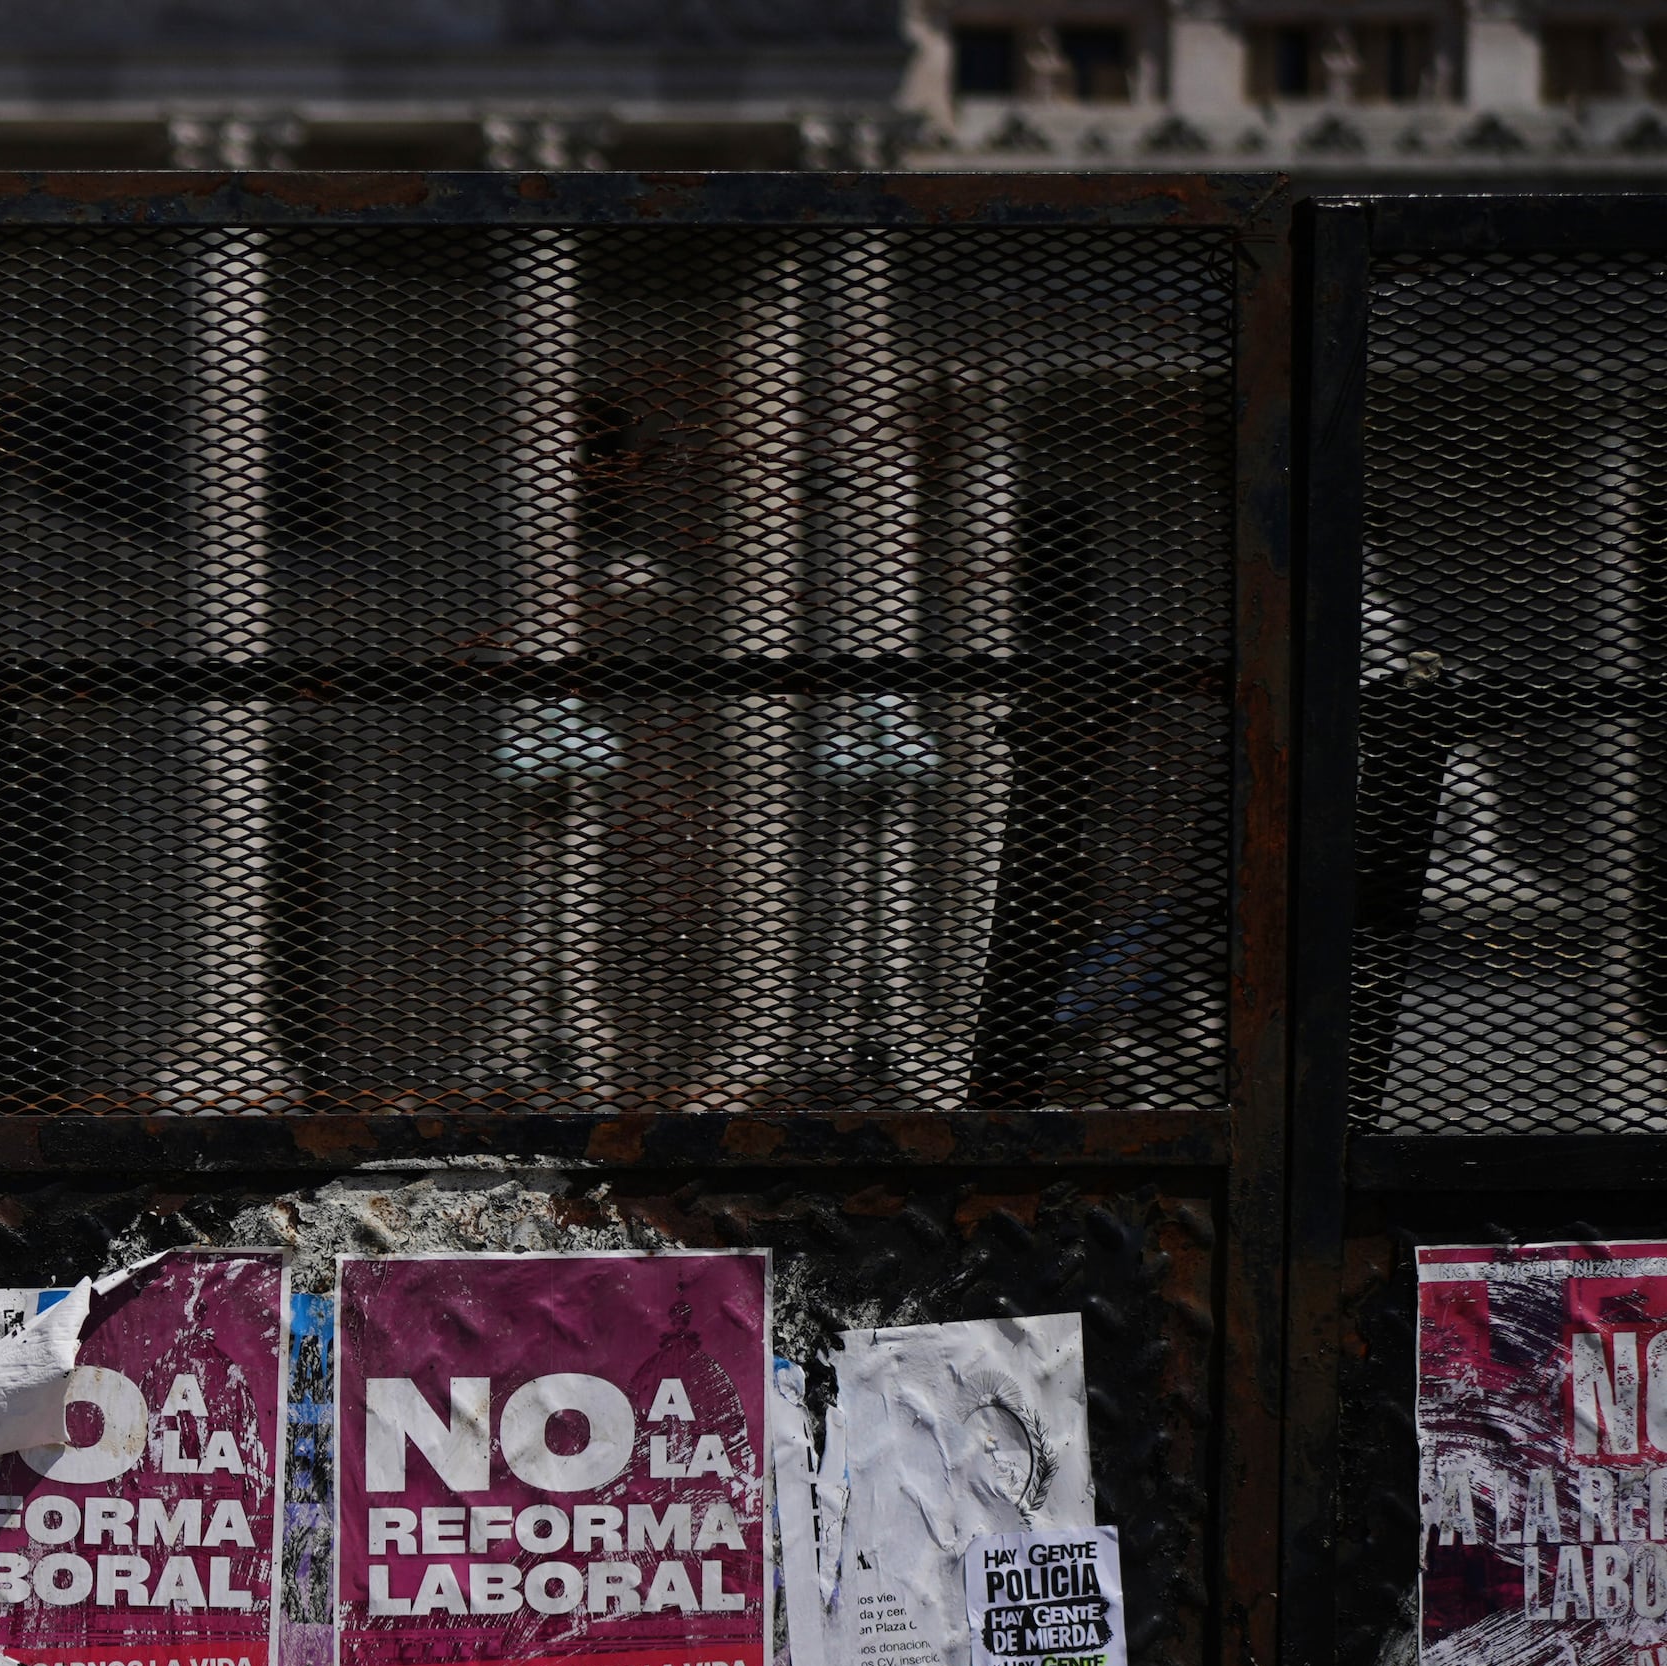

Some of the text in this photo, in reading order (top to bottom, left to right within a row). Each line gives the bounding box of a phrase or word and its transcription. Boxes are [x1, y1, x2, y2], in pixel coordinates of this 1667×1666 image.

[162, 1374, 208, 1417] A
[164, 1431, 244, 1474] LA
[365, 1373, 696, 1493] NO A
[650, 1434, 733, 1479] LA
[1439, 1469, 1561, 1546] A LA
[369, 1504, 746, 1556] REFORMA
[984, 1541, 1098, 1568] HAY GENTE
[369, 1560, 746, 1616] LABORAL
[986, 1559, 1101, 1603] POLICÍA
[876, 1622, 906, 1633] Plaza
[991, 1603, 1100, 1629] HAY GENTE
[993, 1623, 1100, 1652] DE MIERDA
